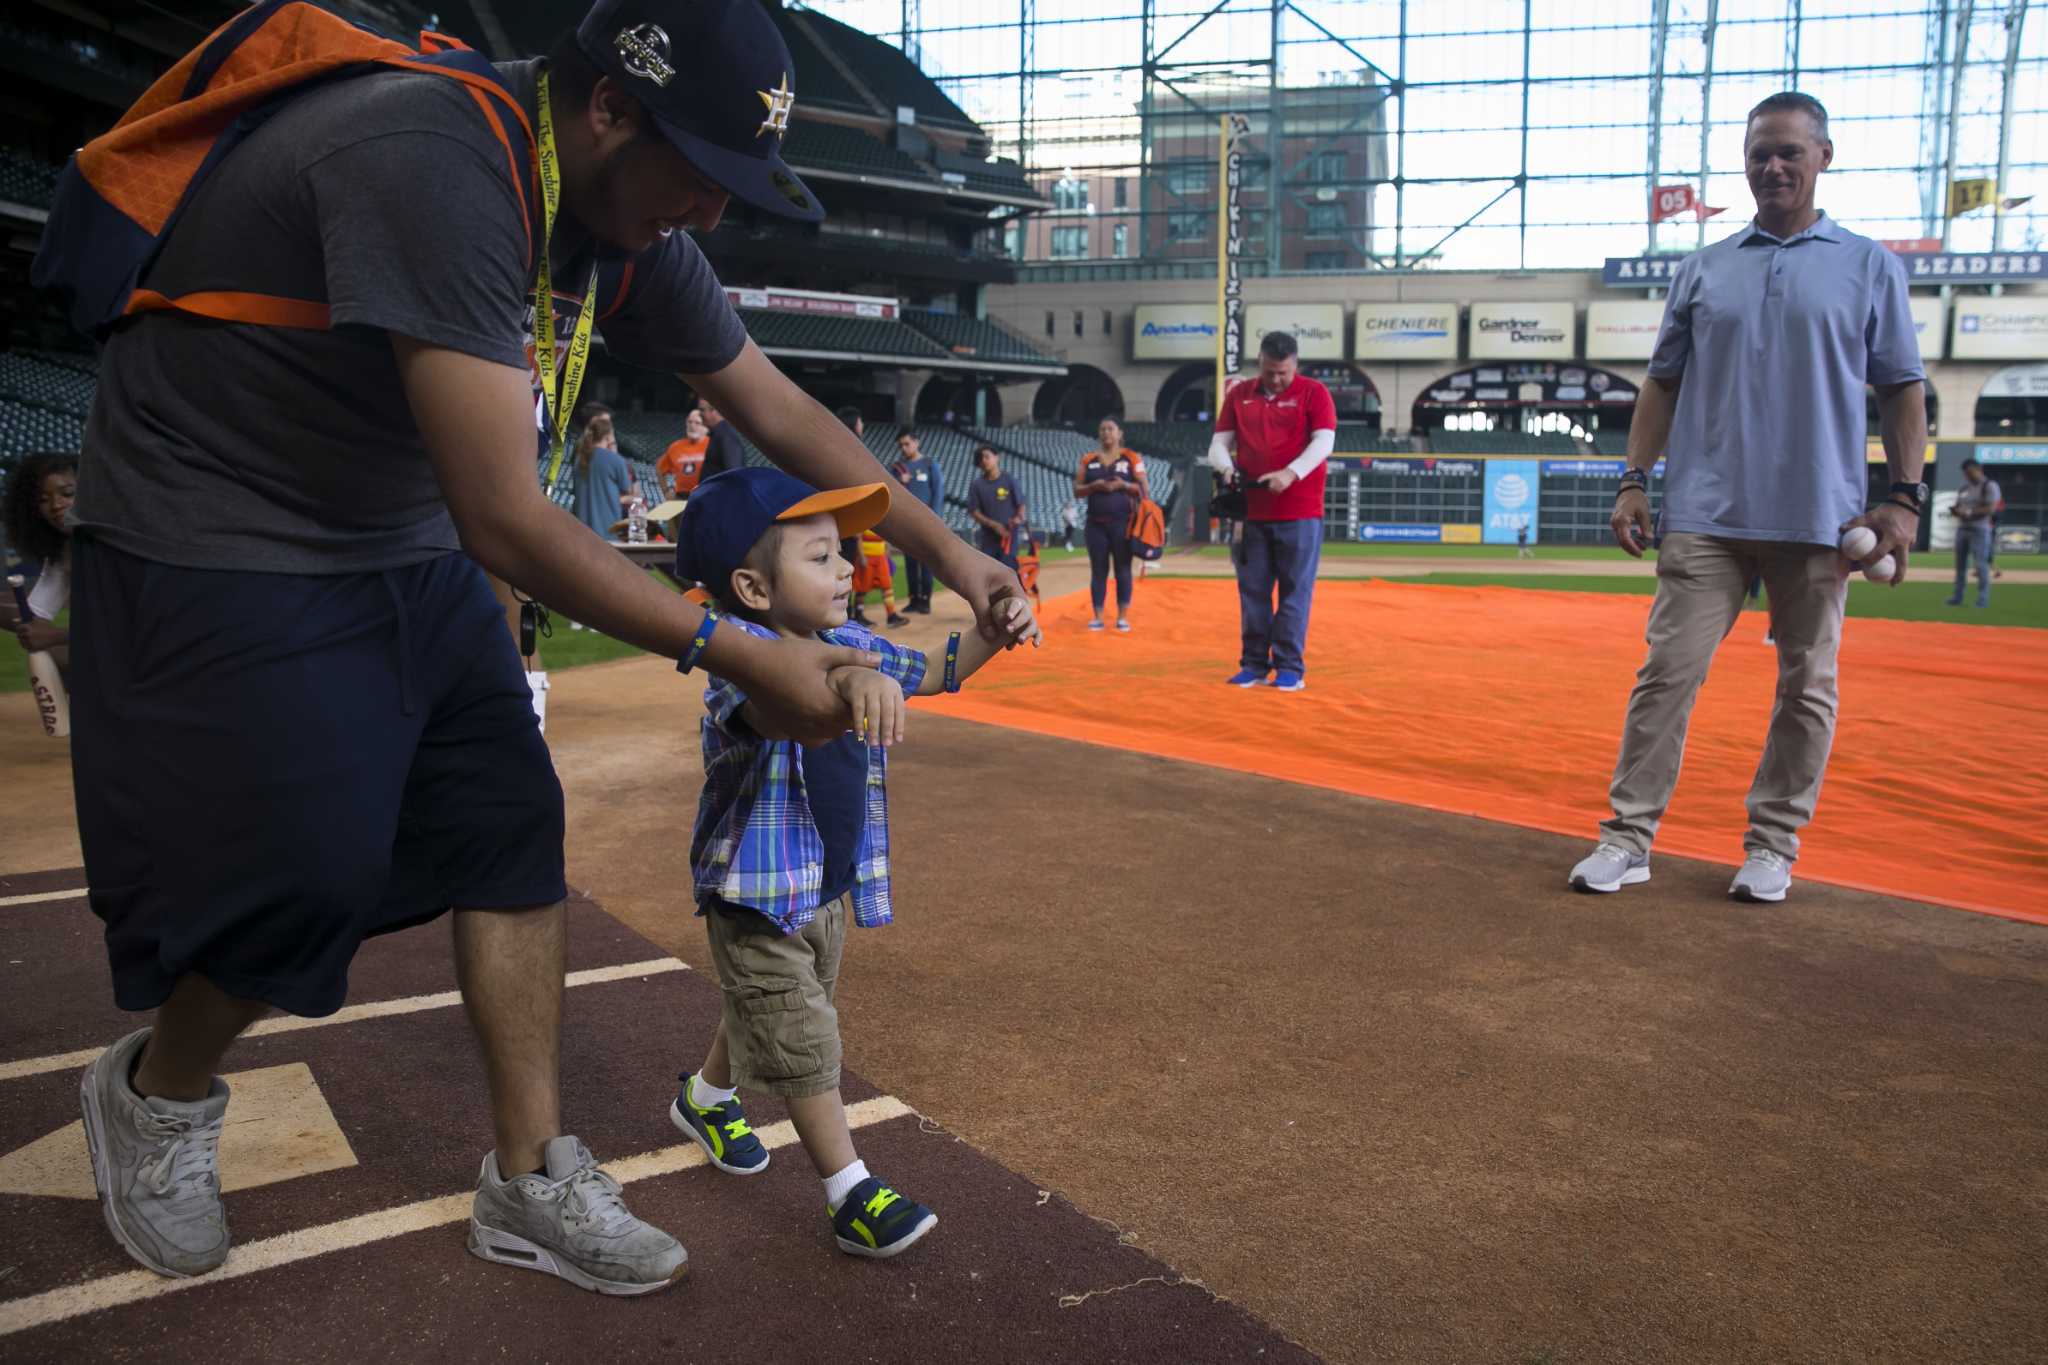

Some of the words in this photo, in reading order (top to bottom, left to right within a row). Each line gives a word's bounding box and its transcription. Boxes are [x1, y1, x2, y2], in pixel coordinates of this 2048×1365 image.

[540, 120, 552, 145] The
[541, 150, 559, 203] Sunshine
[1660, 190, 1687, 212] 05
[1961, 184, 1984, 205] 17
[1914, 256, 2042, 275] LEADERS
[538, 284, 551, 342] Sunshine
[1366, 317, 1449, 330] CHENIERE
[1478, 317, 1539, 330] Gardner
[571, 332, 588, 358] Kids
[1226, 299, 1239, 372] FARE
[1510, 331, 1566, 343] Denver
[539, 347, 553, 377] Kids
[561, 361, 582, 414] Sunshine
[1490, 512, 1531, 529] AT&T
